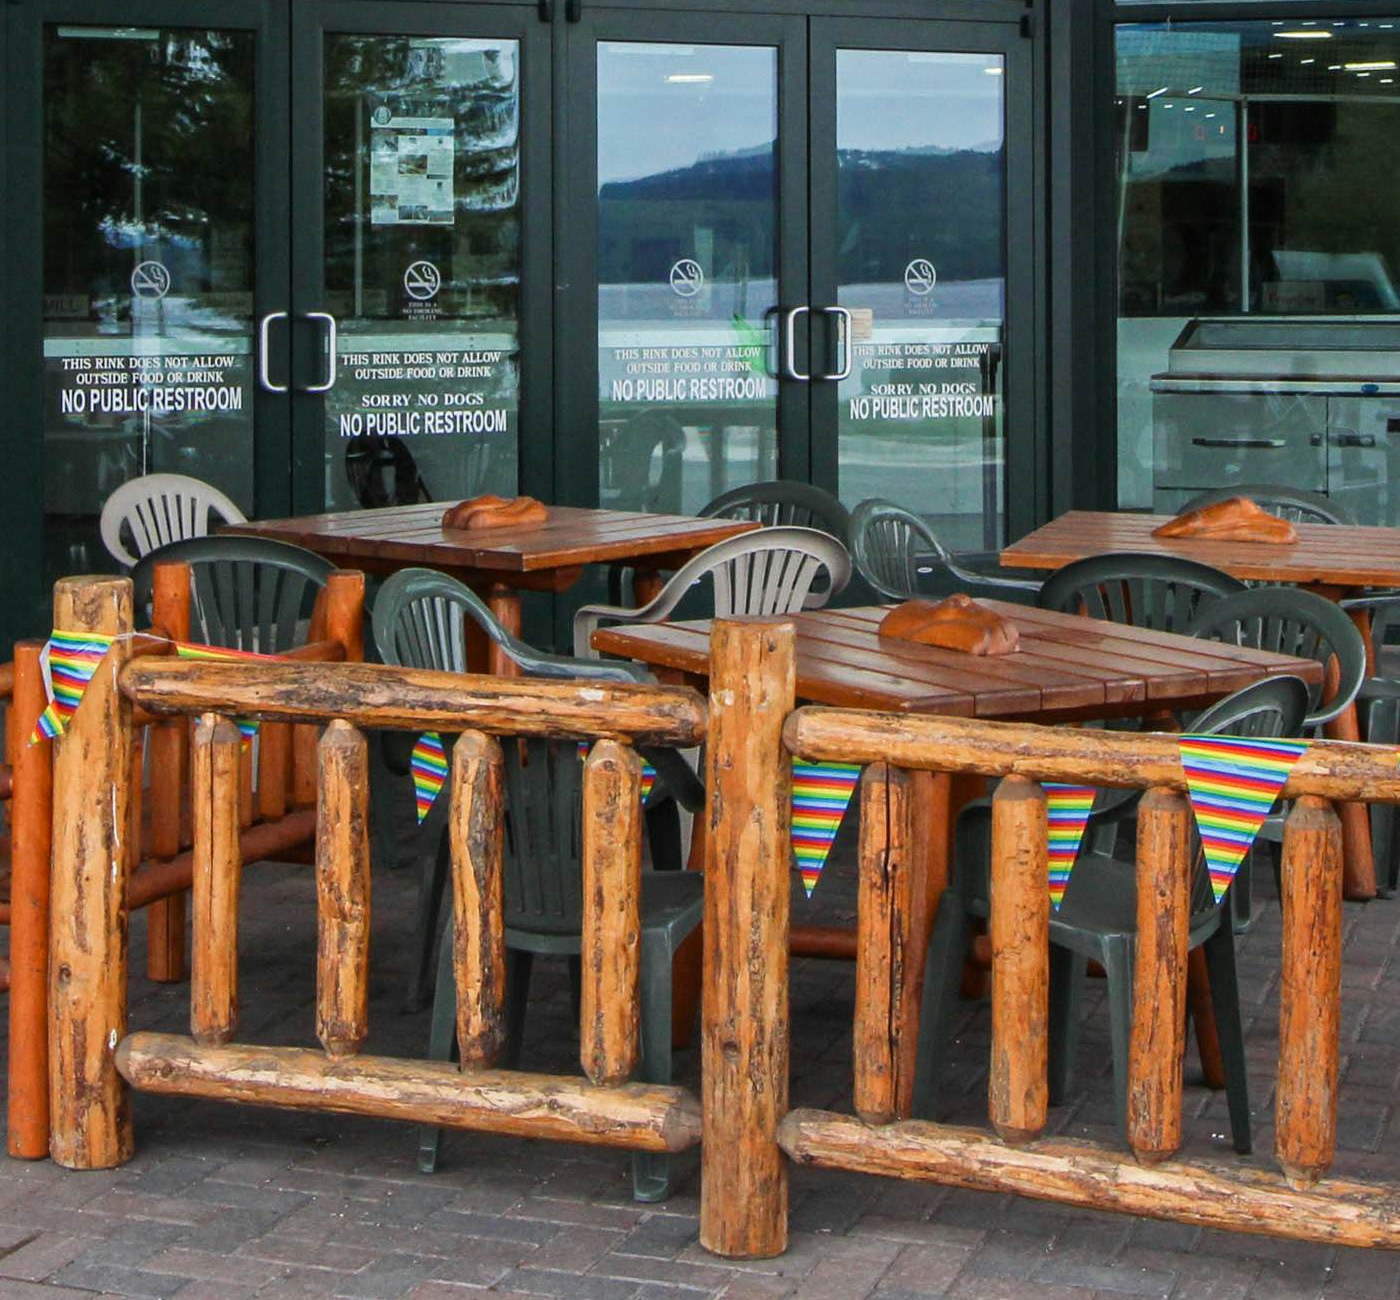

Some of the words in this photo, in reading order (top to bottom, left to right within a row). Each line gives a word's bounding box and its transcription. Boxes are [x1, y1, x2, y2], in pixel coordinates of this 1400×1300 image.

[616, 349, 639, 360] THIS
[643, 349, 668, 359] RINK
[672, 348, 698, 358] DOES
[702, 348, 722, 357] NOT
[726, 347, 761, 357] ALLOW
[854, 346, 875, 355] THIS
[878, 346, 902, 355] RINK
[905, 345, 929, 355] DOES
[933, 345, 951, 354] NOT
[955, 345, 988, 354] ALLOW
[63, 358, 91, 369] THIS
[95, 358, 125, 368] RINK
[130, 357, 160, 368] DOES
[165, 357, 187, 368] NOT
[192, 357, 234, 368] ALLOW
[342, 354, 369, 365] THIS
[373, 354, 400, 364] RINK
[404, 353, 433, 364] DOES
[437, 353, 458, 363] NOT
[462, 352, 501, 363] ALLOW
[864, 359, 903, 369] OUTSIDE
[907, 358, 932, 368] FOOD
[935, 358, 947, 367] OR
[951, 358, 979, 367] DRINK
[355, 368, 403, 379] OUTSIDE
[407, 368, 435, 378] FOOD
[439, 367, 454, 378] OR
[458, 367, 491, 377] DRINK
[627, 363, 670, 373] OUTSIDE
[674, 363, 700, 372] FOOD
[704, 362, 717, 372] OR
[721, 362, 752, 371] DRINK
[76, 373, 127, 384] OUTSIDE
[132, 372, 163, 383] FOOD
[167, 372, 183, 382] OR
[187, 371, 223, 382] DRINK
[613, 380, 633, 401] NO
[637, 379, 686, 401] PUBLIC
[691, 378, 766, 399] RESTROOM
[871, 384, 913, 395] SORRY
[919, 384, 936, 394] NO
[942, 383, 976, 394] DOGS
[62, 389, 85, 412] NO
[90, 388, 148, 412] PUBLIC
[154, 387, 242, 410] RESTROOM
[362, 395, 411, 407] SORRY
[417, 394, 438, 405] NO
[445, 393, 484, 405] DOGS
[850, 399, 869, 419] NO
[873, 398, 918, 418] PUBLIC
[923, 396, 993, 417] RESTROOM
[341, 414, 362, 436] NO
[367, 412, 420, 435] PUBLIC
[425, 410, 506, 433] RESTROOM
